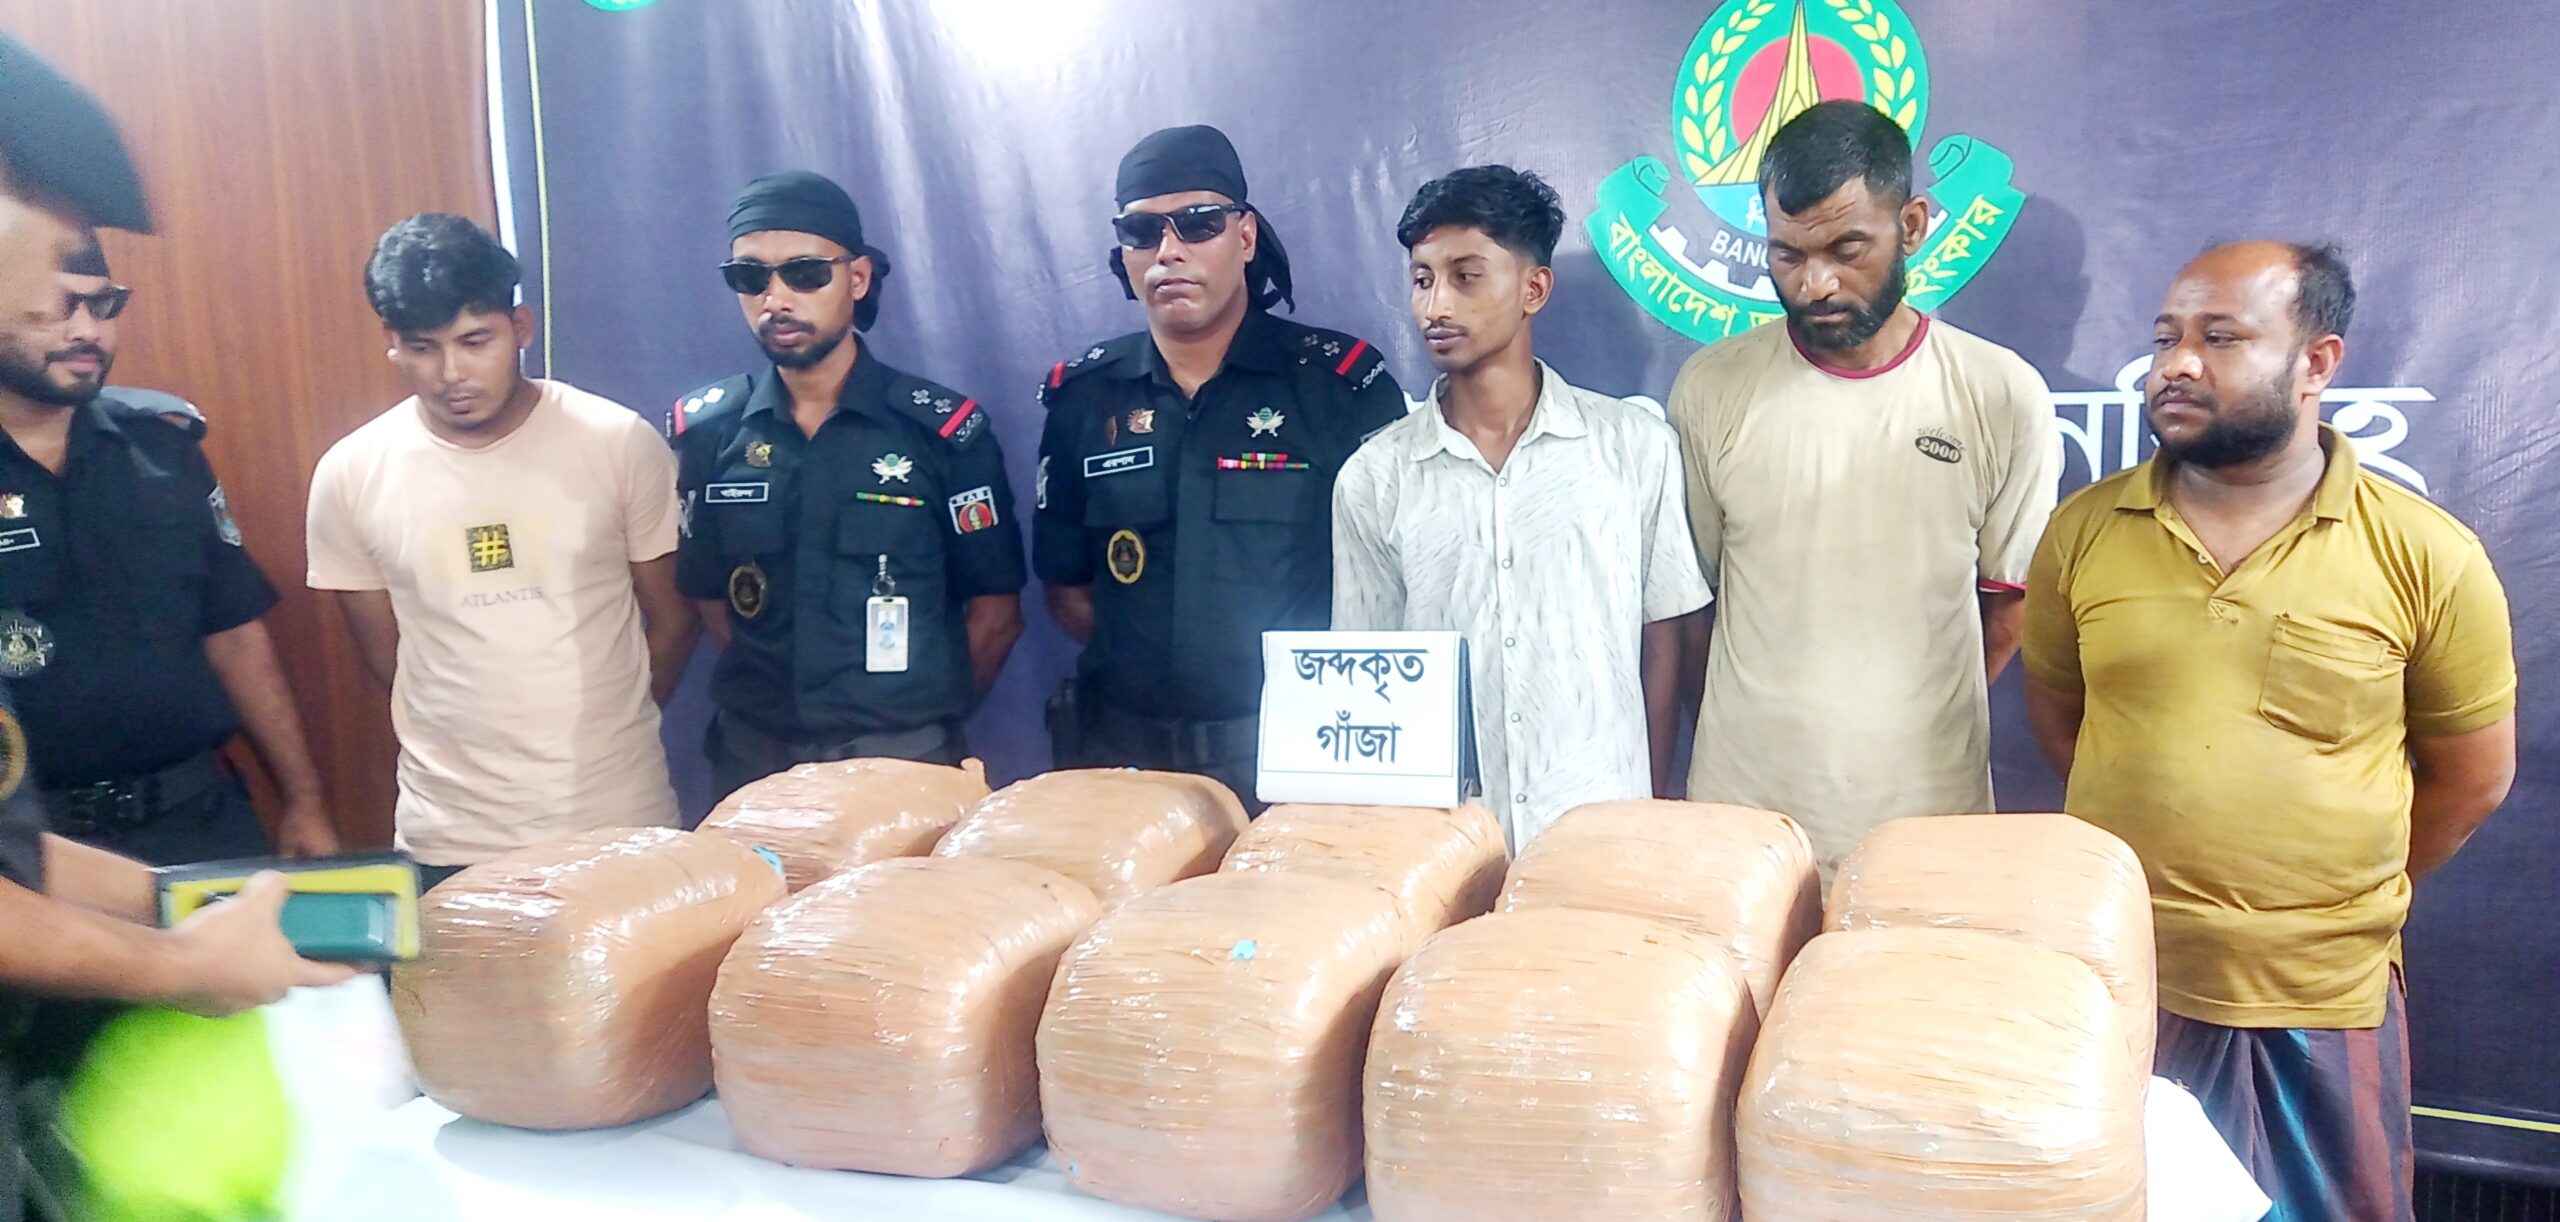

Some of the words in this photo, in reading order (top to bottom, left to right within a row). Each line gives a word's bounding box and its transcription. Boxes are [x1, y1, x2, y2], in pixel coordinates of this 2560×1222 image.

[1609, 211, 1739, 336] বাংলাদেশ
[1918, 437, 1959, 462] 2000
[1289, 648, 1430, 704] জব্দকৃত
[1316, 709, 1404, 764] গাঁজা
